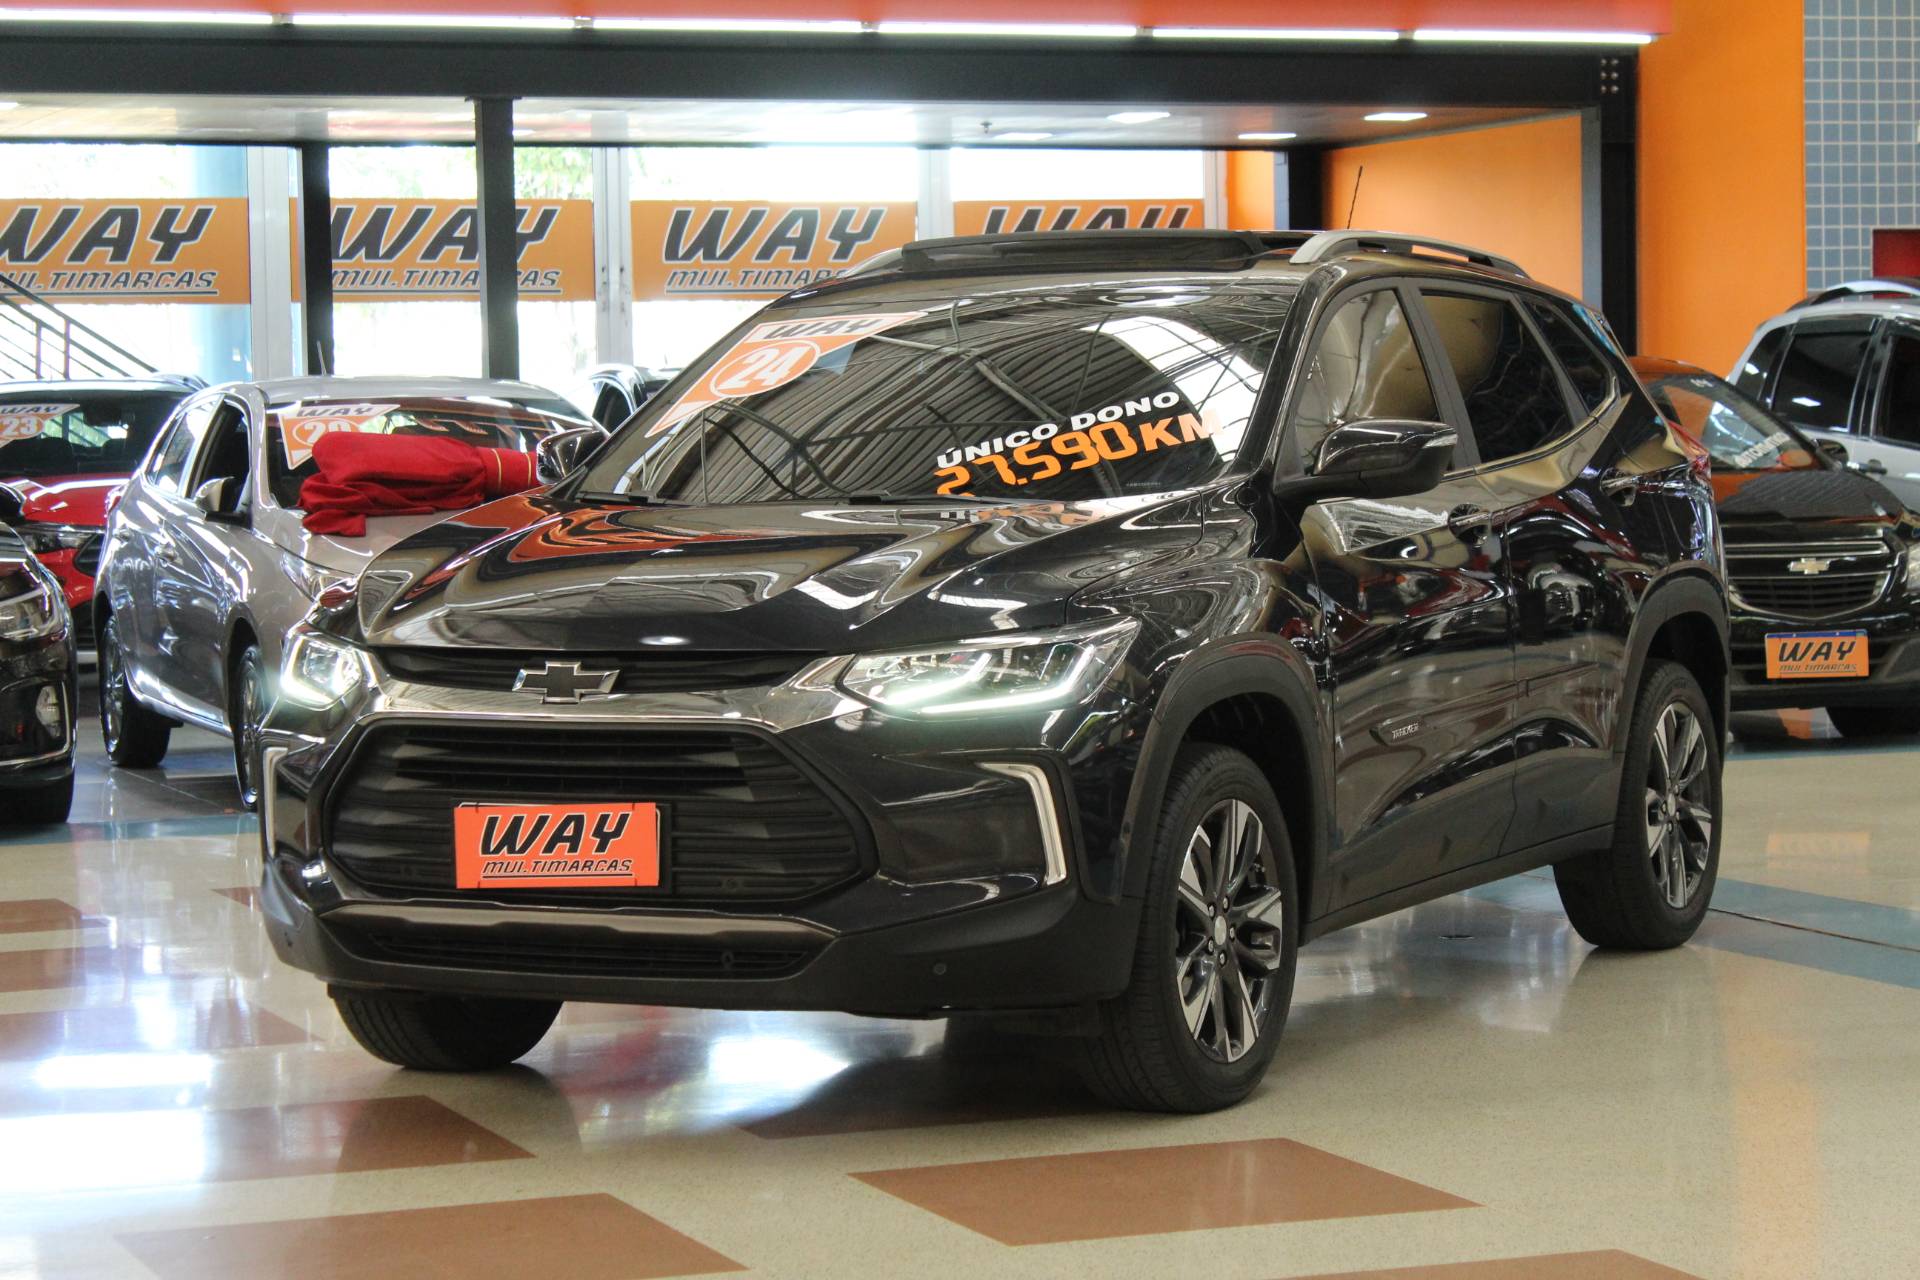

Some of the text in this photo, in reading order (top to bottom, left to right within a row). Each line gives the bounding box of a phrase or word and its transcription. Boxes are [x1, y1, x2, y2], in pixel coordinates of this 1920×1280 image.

[330, 206, 561, 263] WAY
[662, 207, 888, 263] WAY
[331, 269, 561, 287] MULTIMAAS
[762, 318, 885, 340] WAY
[716, 346, 814, 390] 24
[0, 416, 37, 436] 23
[937, 391, 1180, 469] ÚNICO DONO
[933, 410, 1223, 497] 27.590 KM
[1778, 641, 1856, 662] WAY
[479, 812, 633, 857] WAY
[482, 859, 633, 874] MULTIMARCAS
